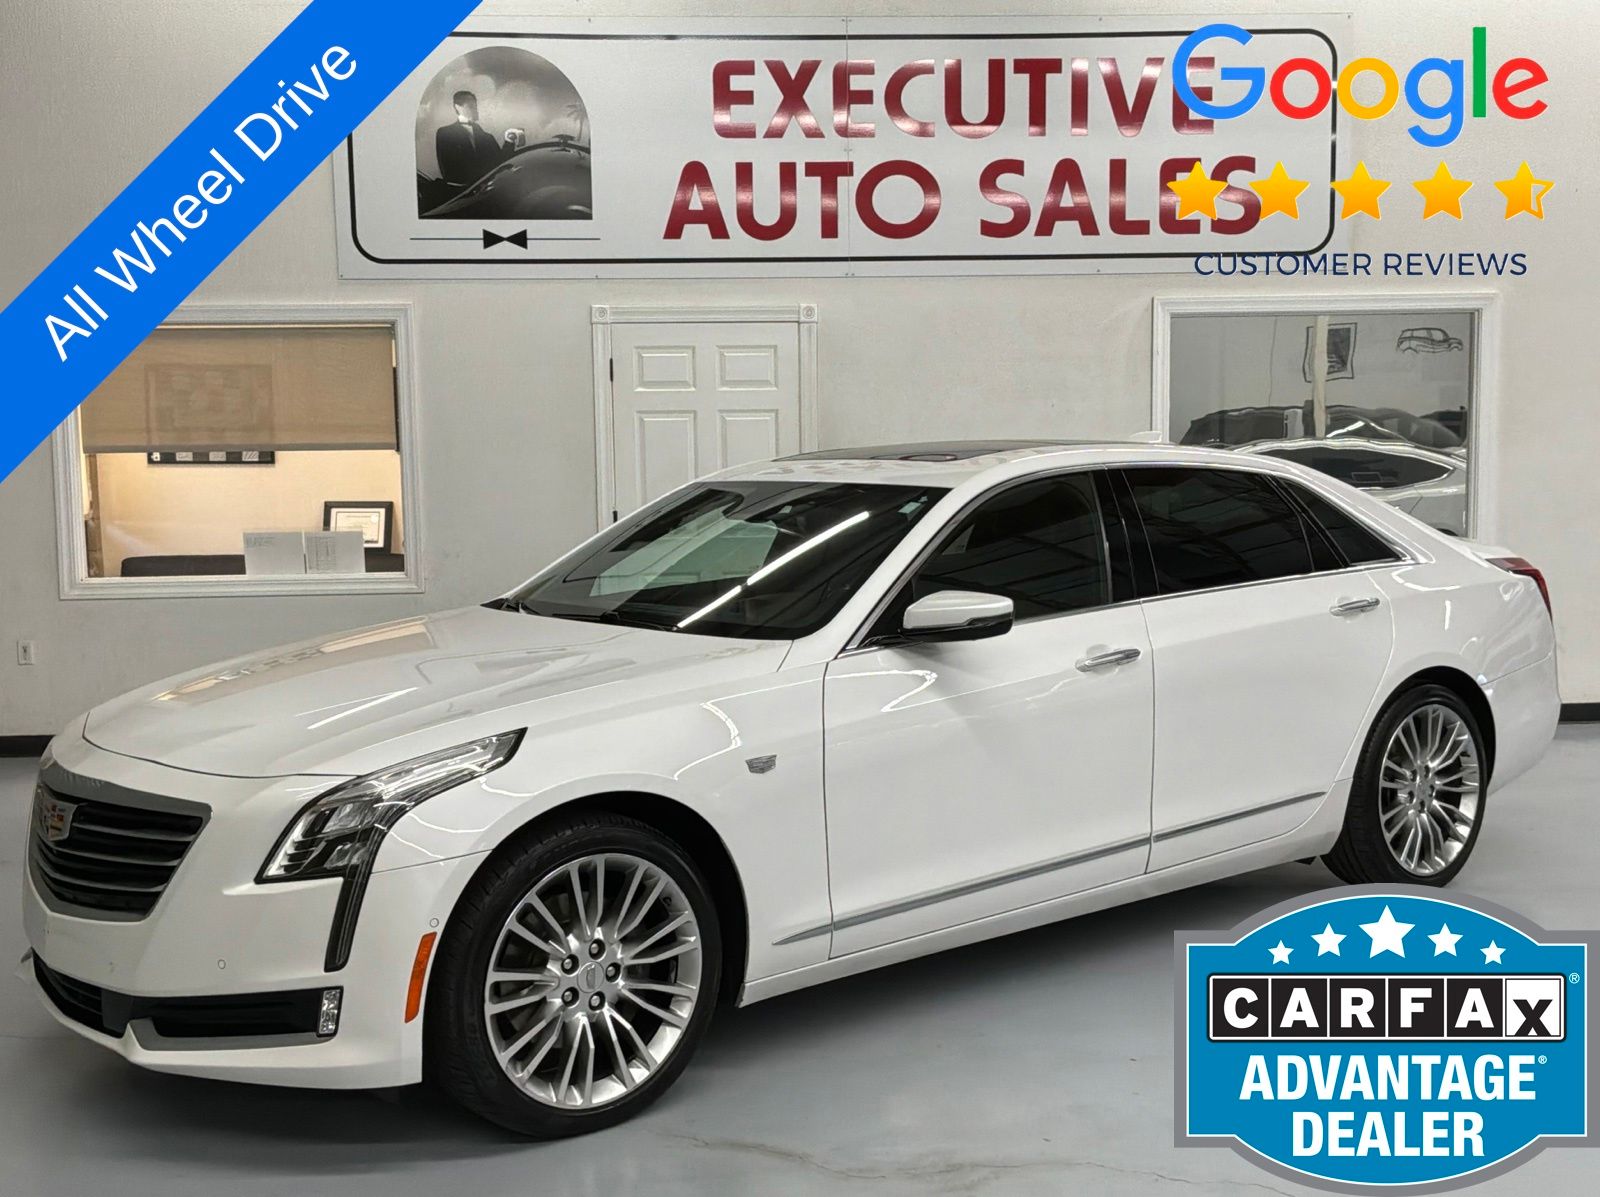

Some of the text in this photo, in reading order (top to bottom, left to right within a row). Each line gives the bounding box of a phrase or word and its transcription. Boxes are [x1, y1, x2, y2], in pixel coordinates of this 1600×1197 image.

[712, 56, 1216, 139] EXECUTIVE
[663, 155, 1262, 241] AUTO SALES
